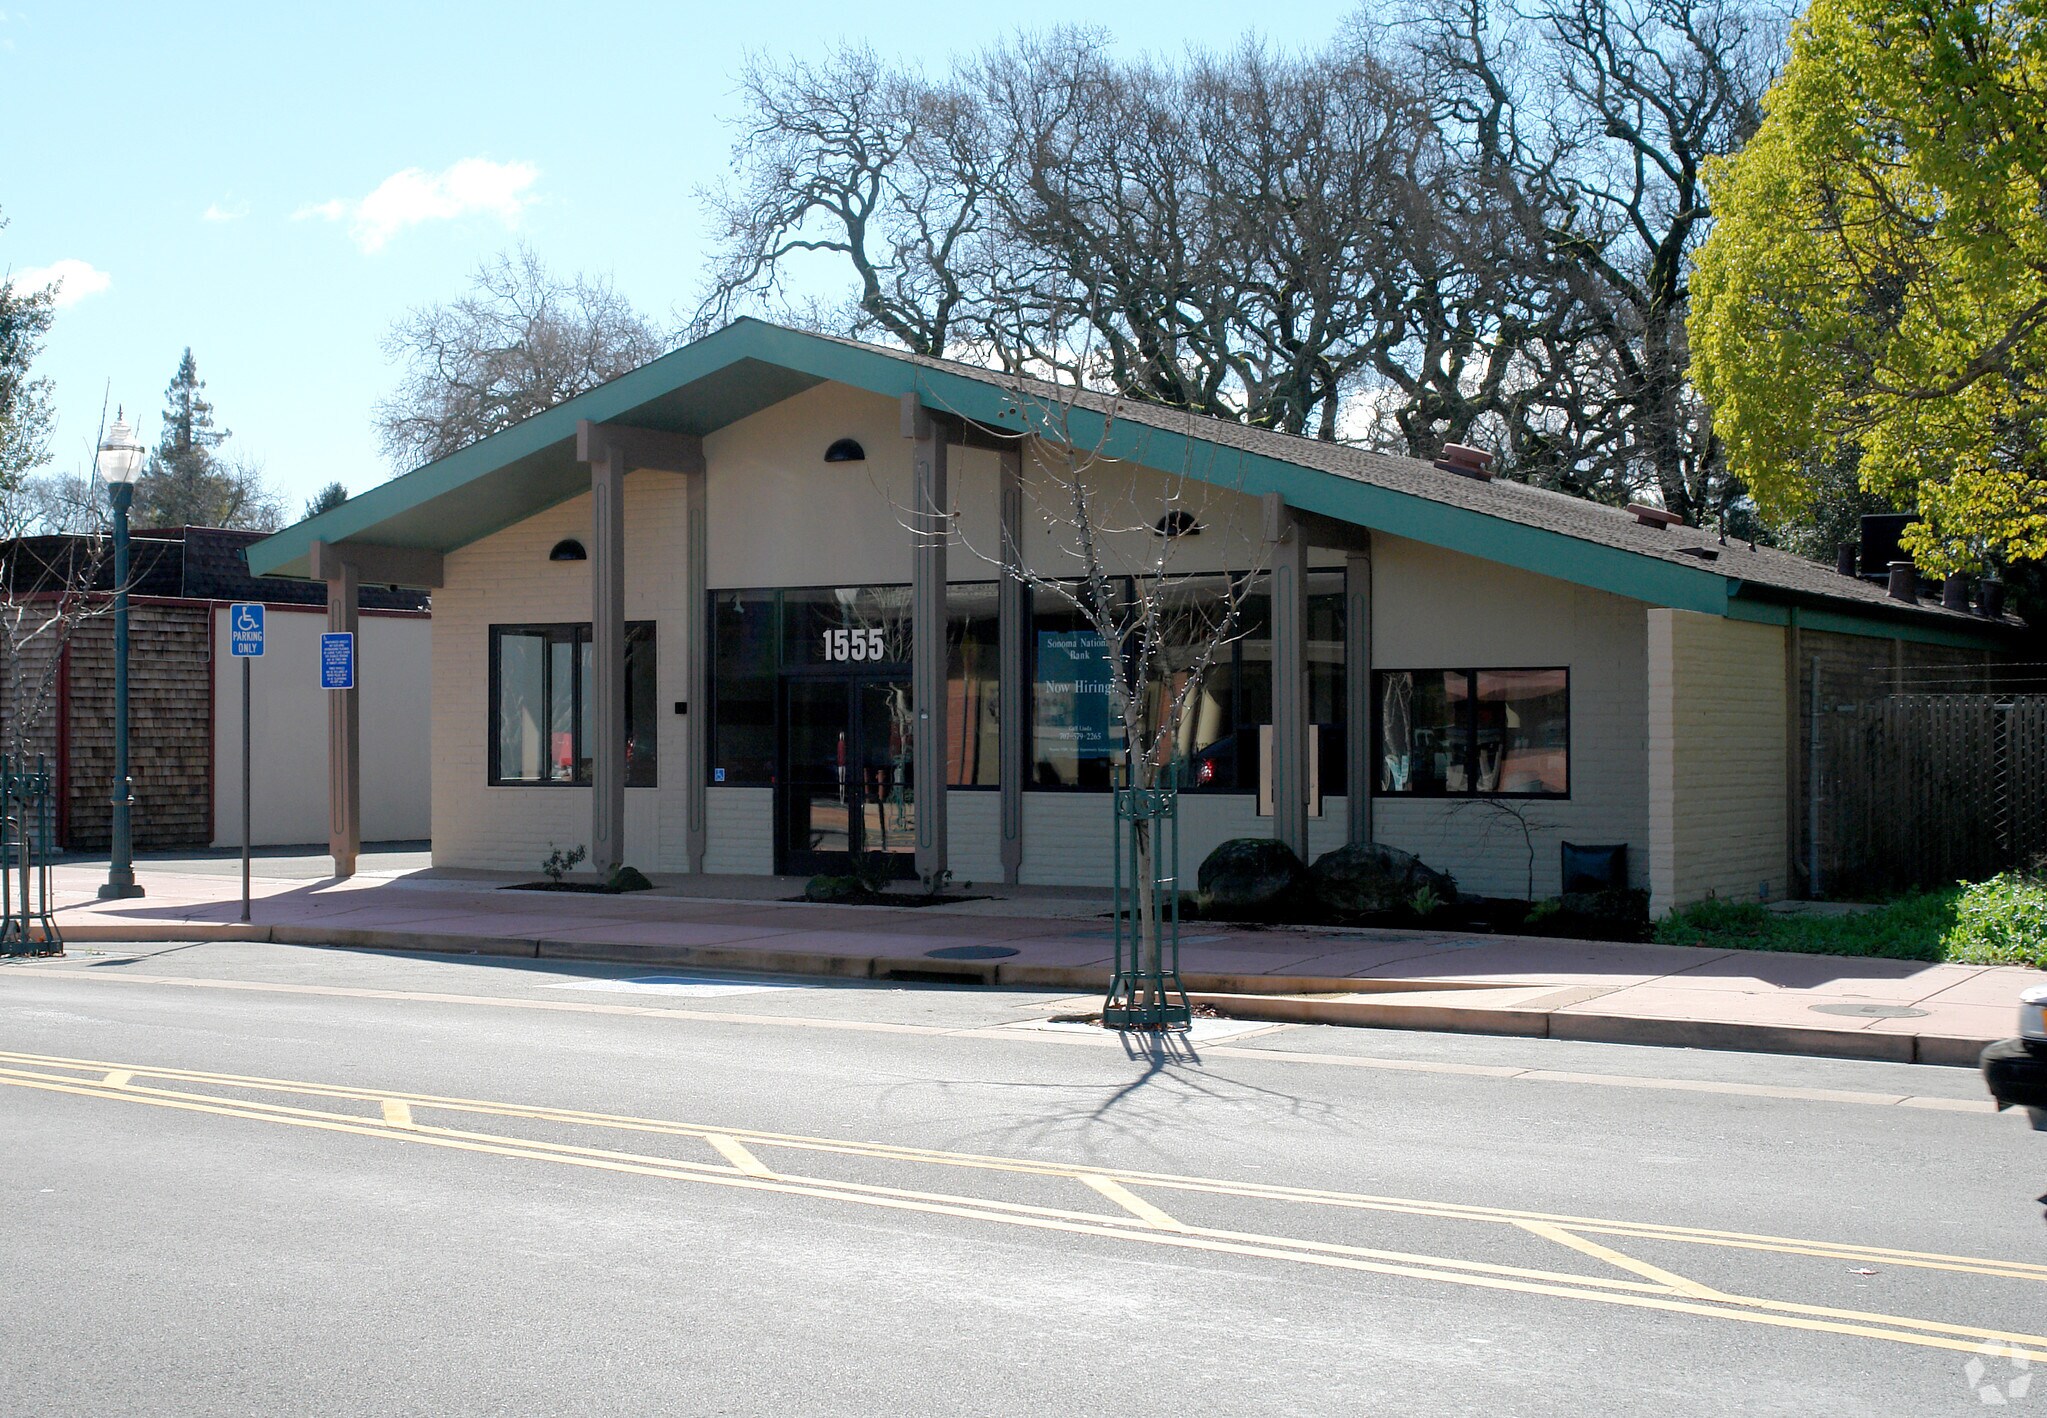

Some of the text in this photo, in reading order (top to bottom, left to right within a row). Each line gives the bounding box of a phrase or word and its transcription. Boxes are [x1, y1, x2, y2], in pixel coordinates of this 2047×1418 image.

[233, 631, 262, 642] PARKING
[823, 628, 884, 661] 1555
[1047, 637, 1107, 648] Sonoma Nation
[238, 643, 257, 654] ONLY
[1070, 650, 1090, 660] Bank
[1046, 679, 1070, 693] Now
